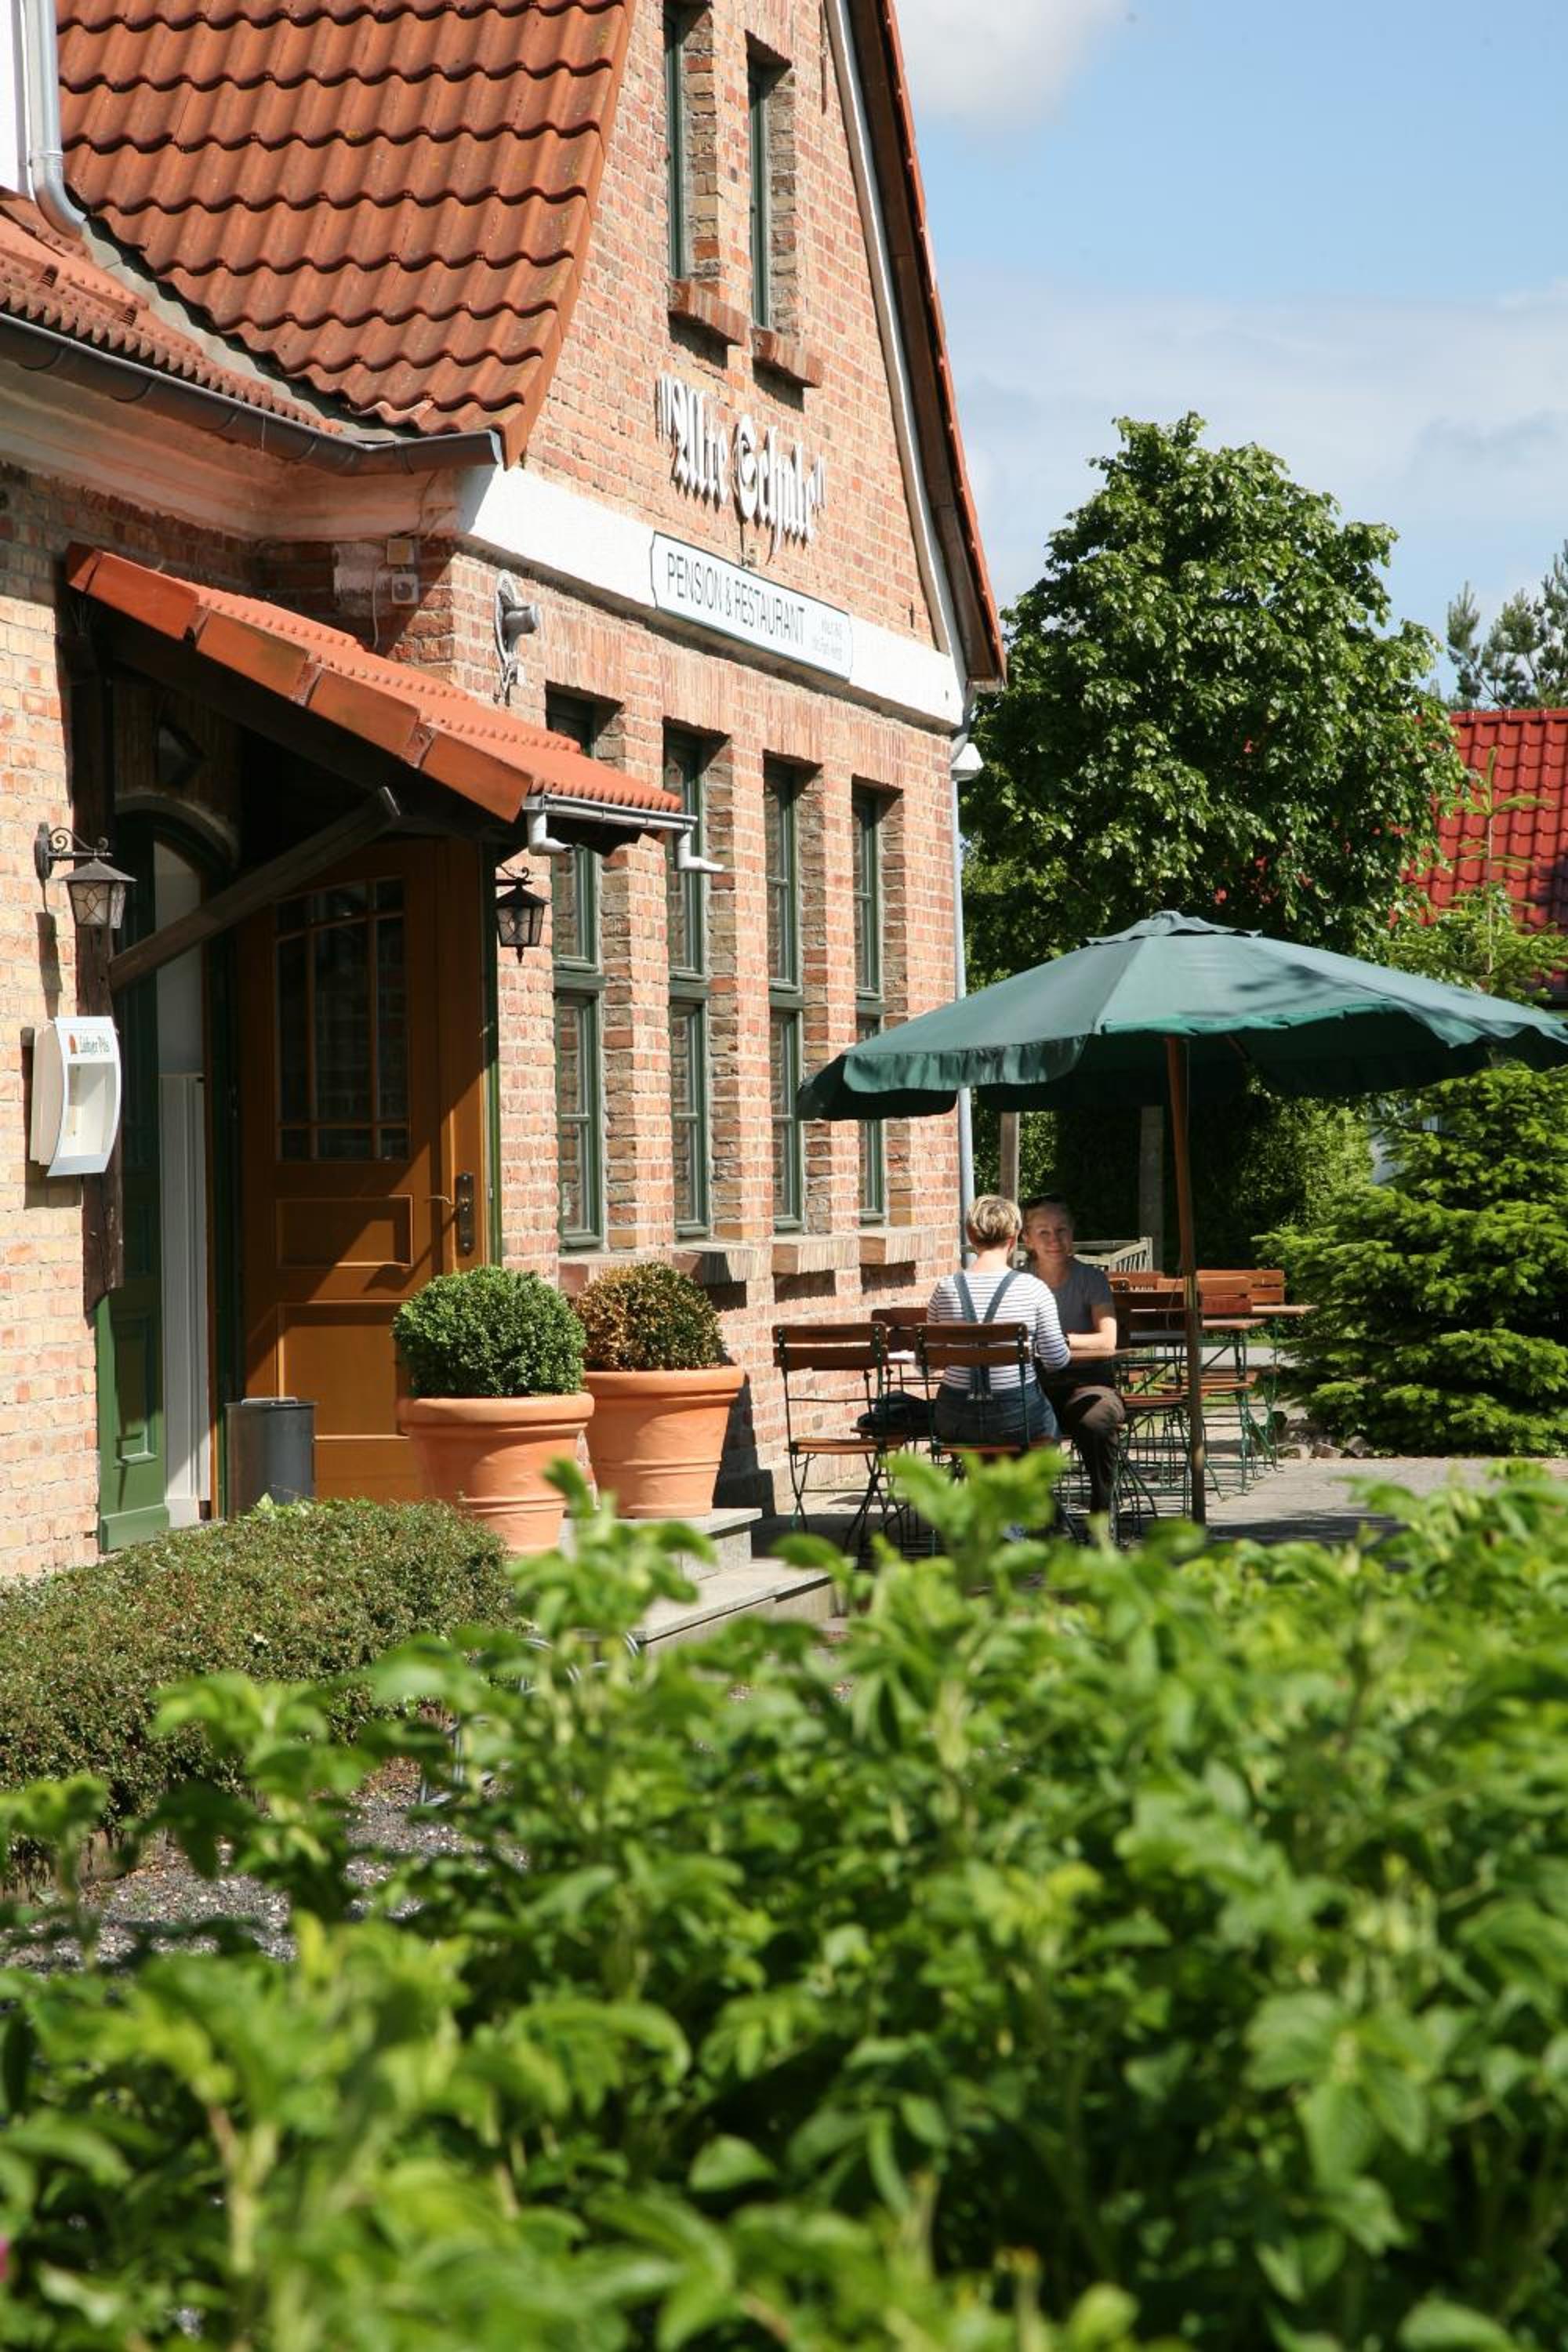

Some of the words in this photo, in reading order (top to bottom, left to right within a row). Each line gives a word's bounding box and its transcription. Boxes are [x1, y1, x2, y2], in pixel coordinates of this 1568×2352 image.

[667, 552, 723, 613] PENSION
[724, 576, 733, 618] &
[735, 580, 805, 646] RESTAURANT
